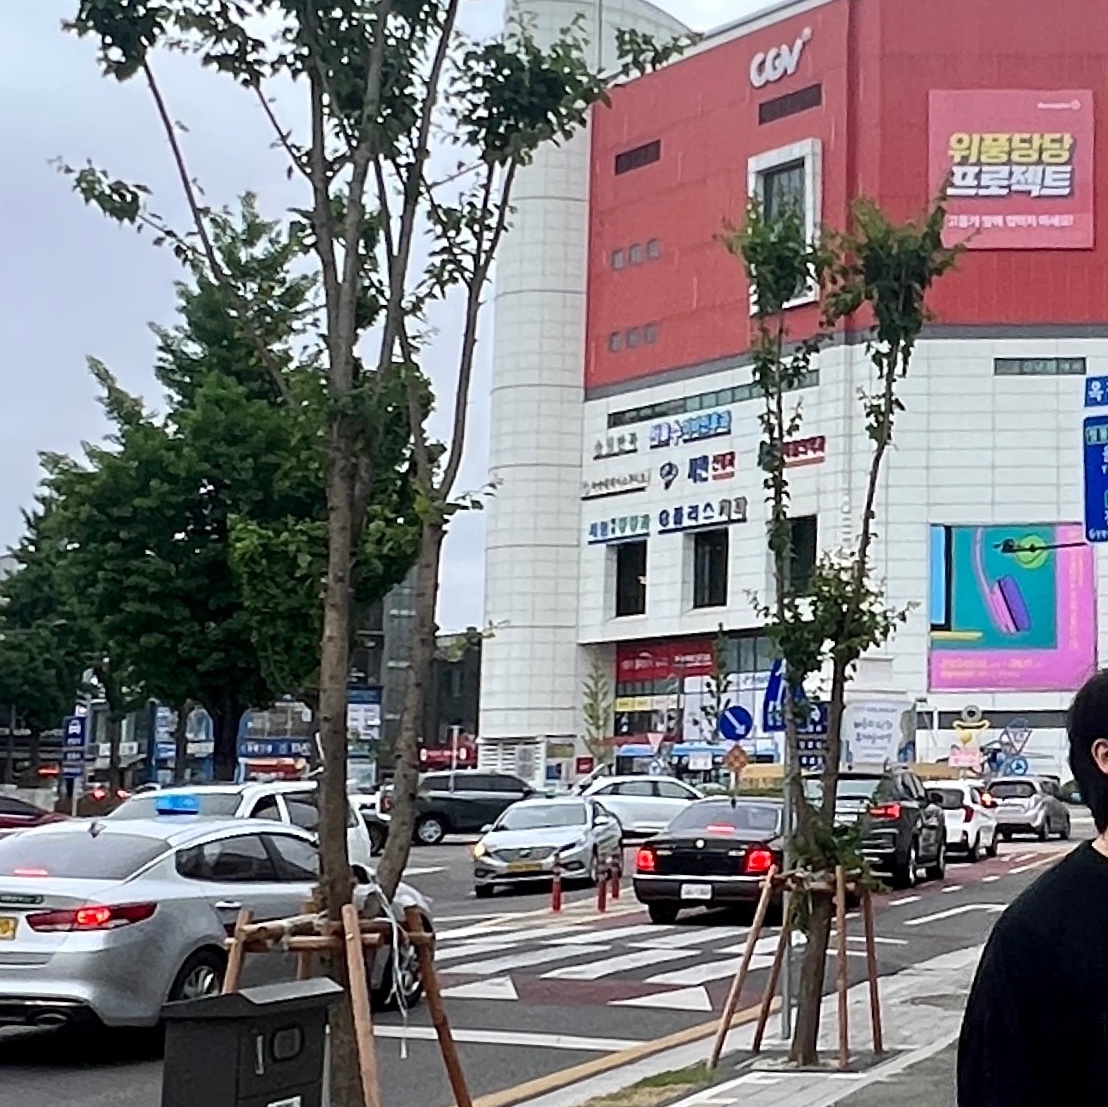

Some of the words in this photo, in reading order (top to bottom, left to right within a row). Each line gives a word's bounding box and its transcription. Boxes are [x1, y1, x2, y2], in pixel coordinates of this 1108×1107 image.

[750, 34, 806, 88] CGV
[948, 132, 1073, 164] 위풍당당
[946, 165, 1073, 197] 프로젝트
